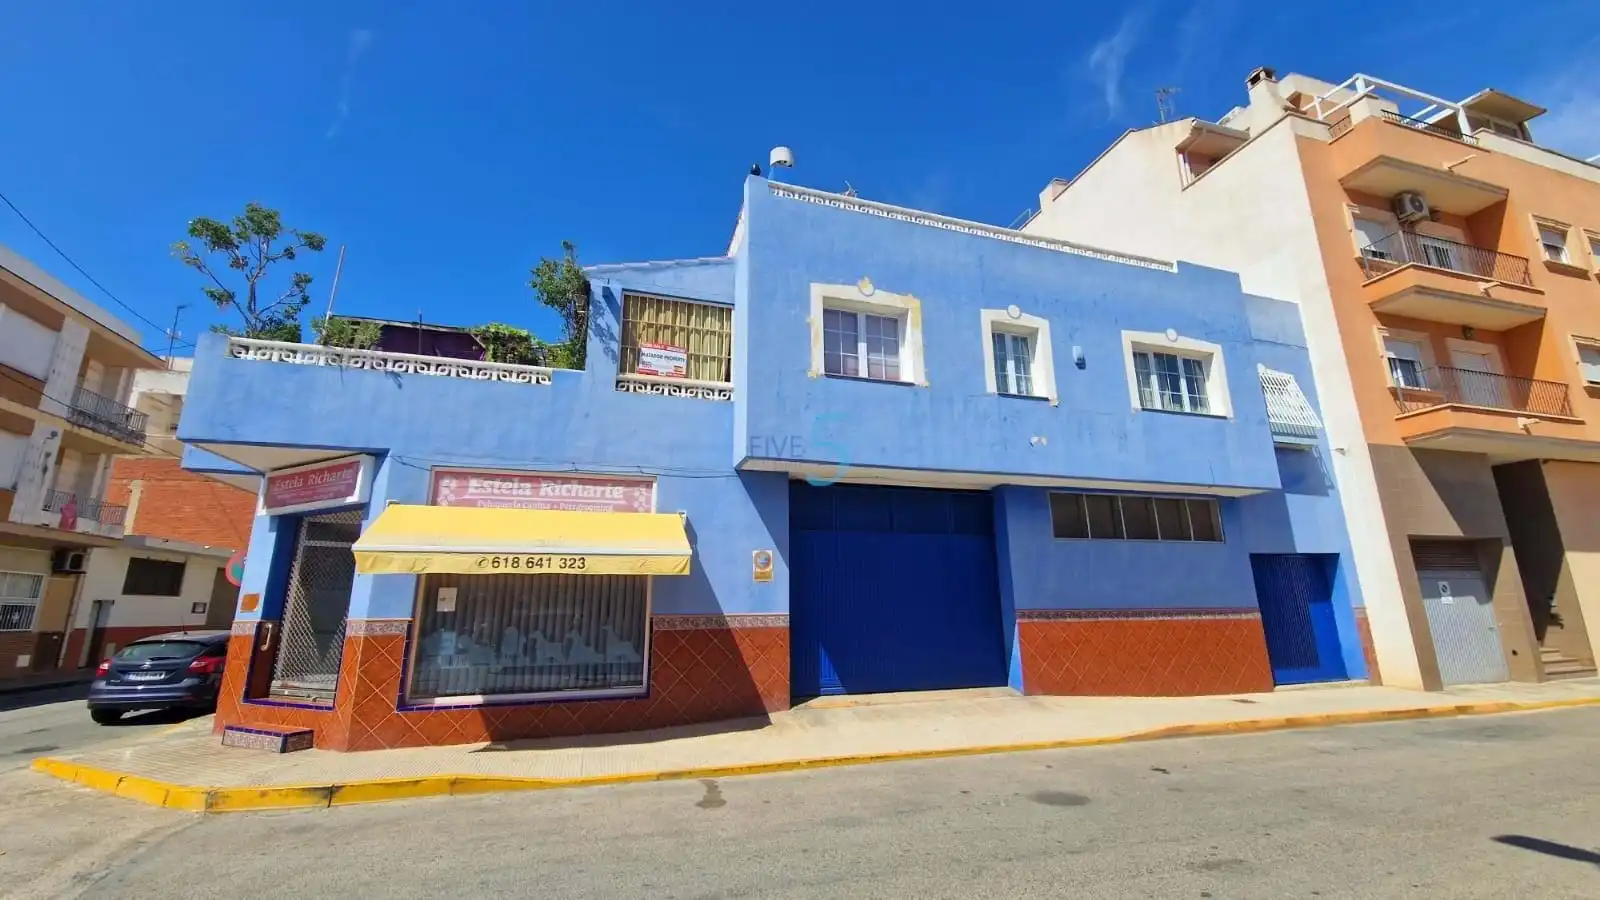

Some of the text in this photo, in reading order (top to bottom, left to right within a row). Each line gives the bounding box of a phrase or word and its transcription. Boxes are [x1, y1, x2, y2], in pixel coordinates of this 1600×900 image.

[275, 468, 353, 490] Estela Richarte
[468, 476, 623, 498] Estela Richarte
[491, 556, 586, 570] 618 641 323
